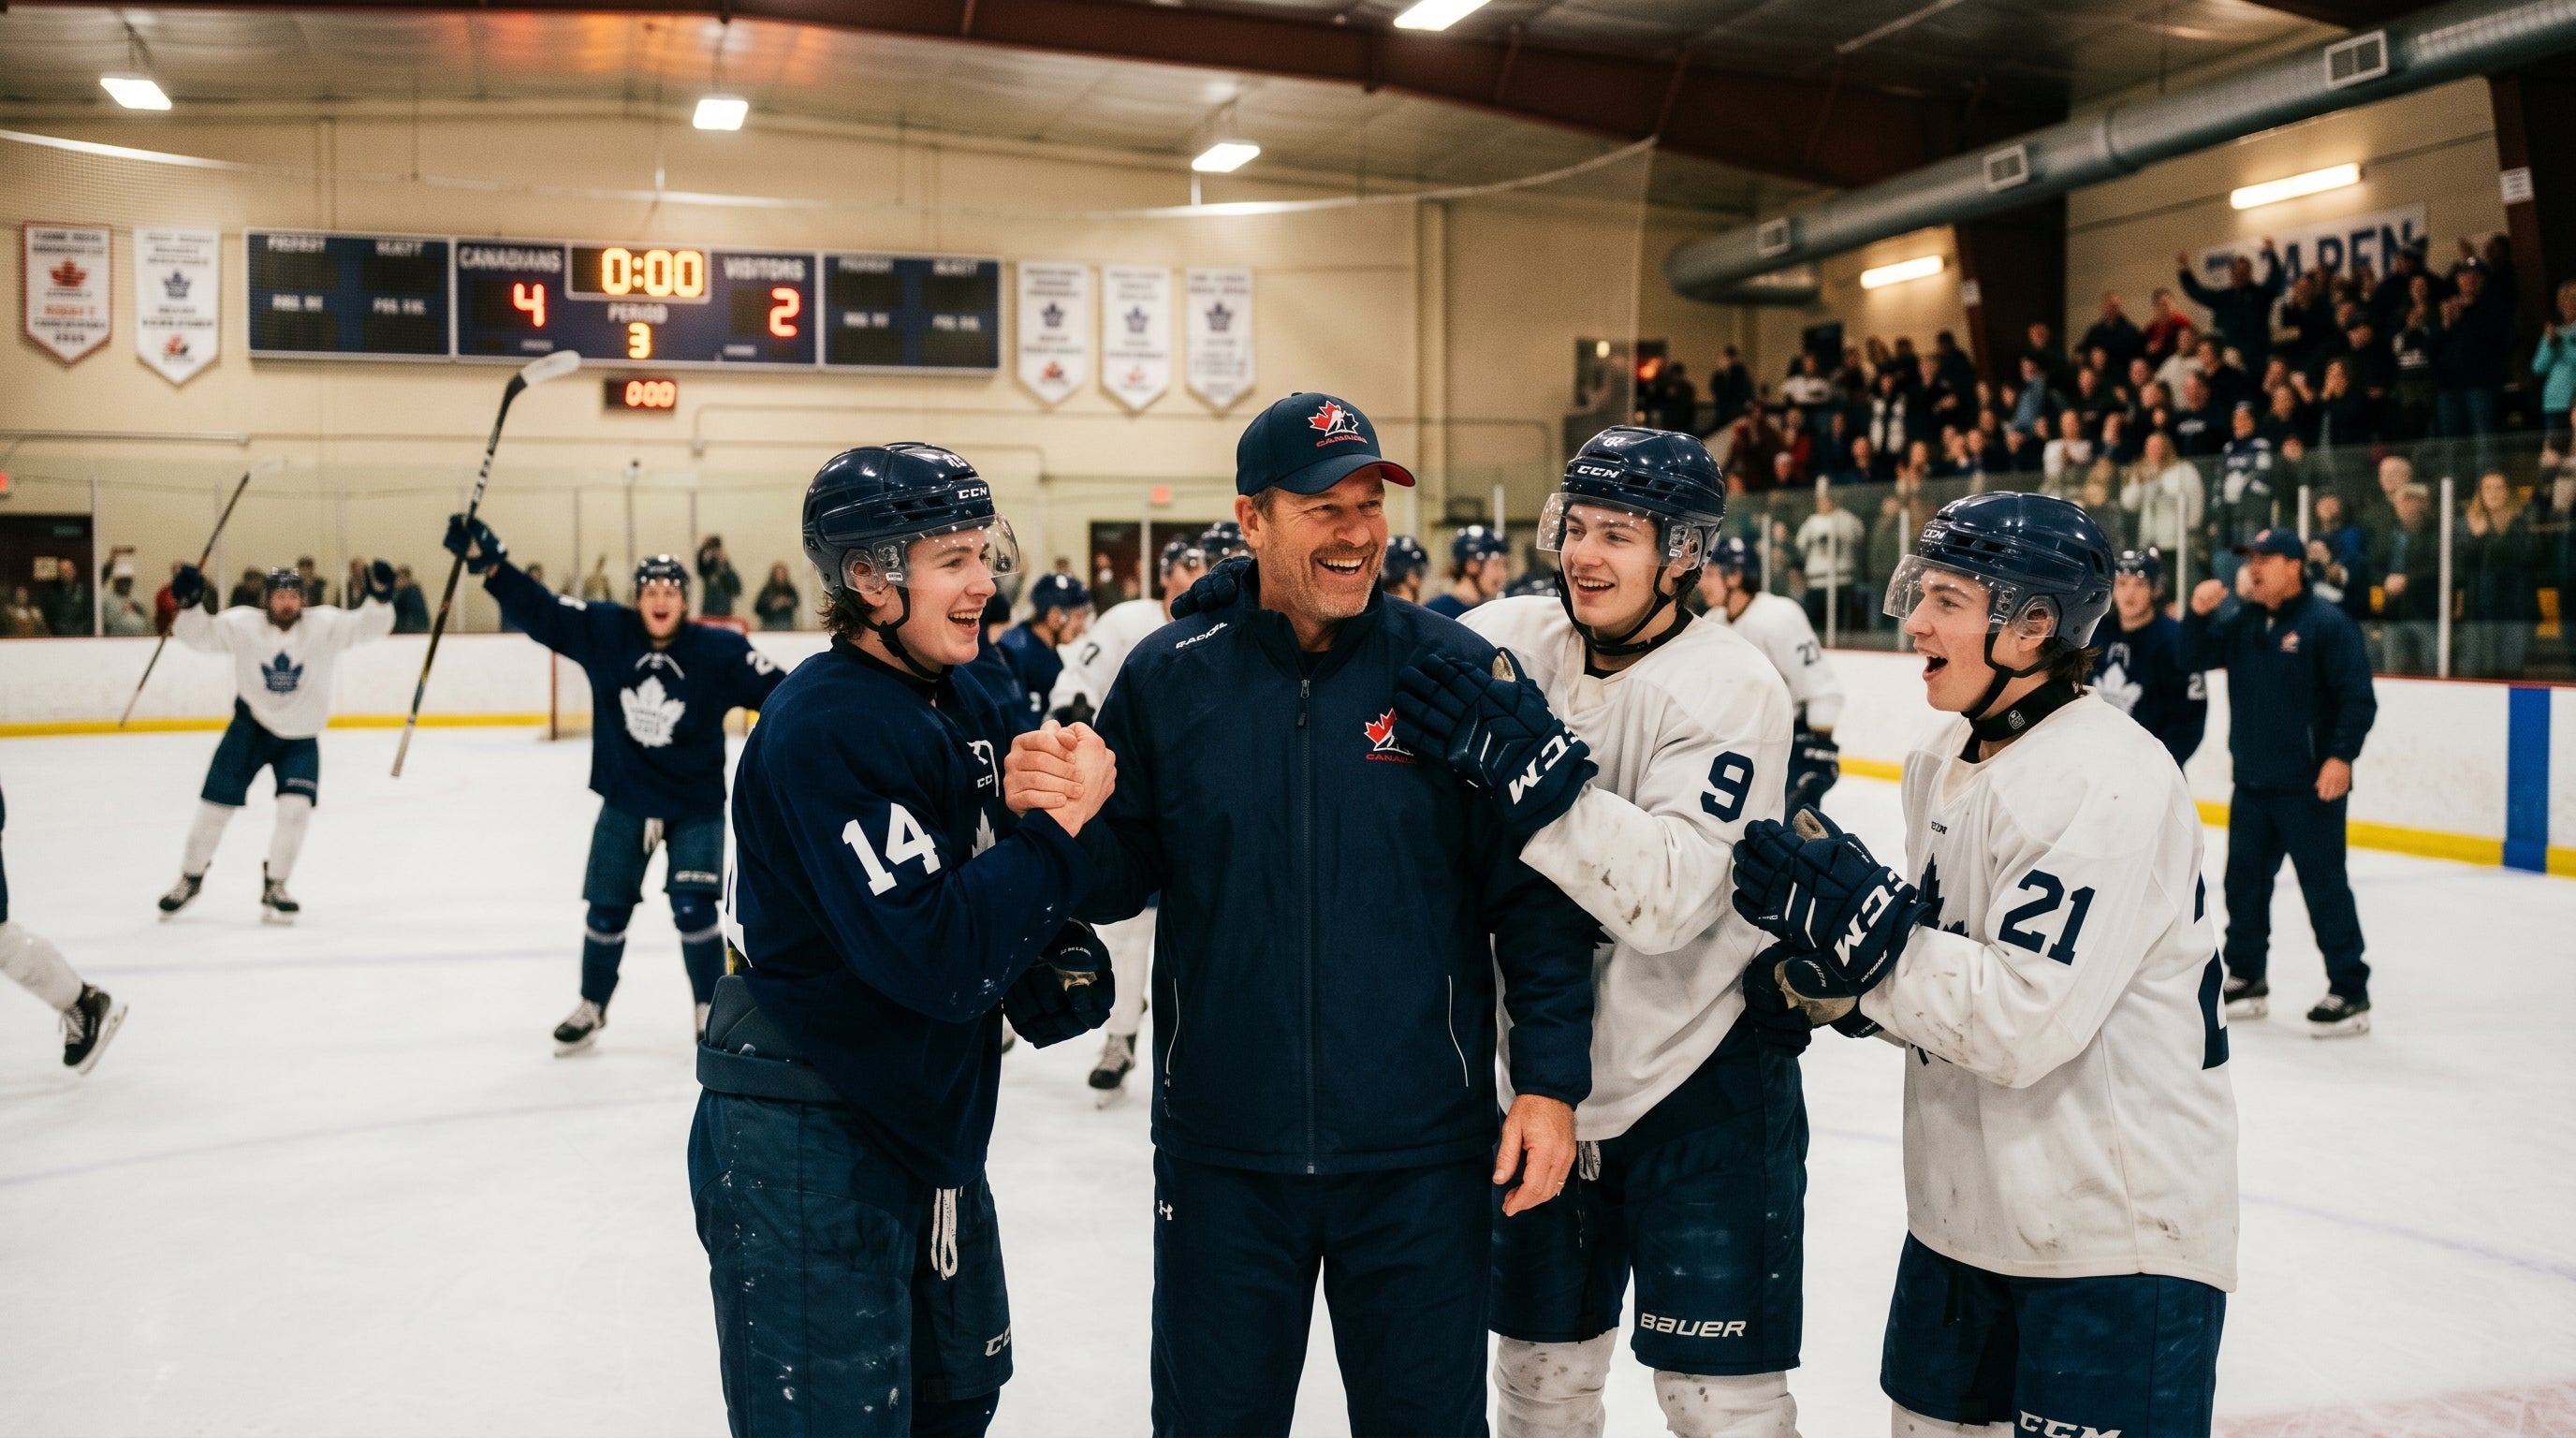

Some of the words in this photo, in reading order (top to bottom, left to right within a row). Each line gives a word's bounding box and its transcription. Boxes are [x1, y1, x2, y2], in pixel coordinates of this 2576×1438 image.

[602, 247, 704, 299] 0:00
[513, 283, 546, 328] 4
[607, 302, 668, 324] PERIOD
[768, 286, 800, 337] 2
[628, 321, 651, 360] 3
[1577, 465, 1620, 478] CCM
[1700, 750, 1755, 824] 9
[842, 802, 942, 897] 14
[1998, 869, 2096, 966] 21
